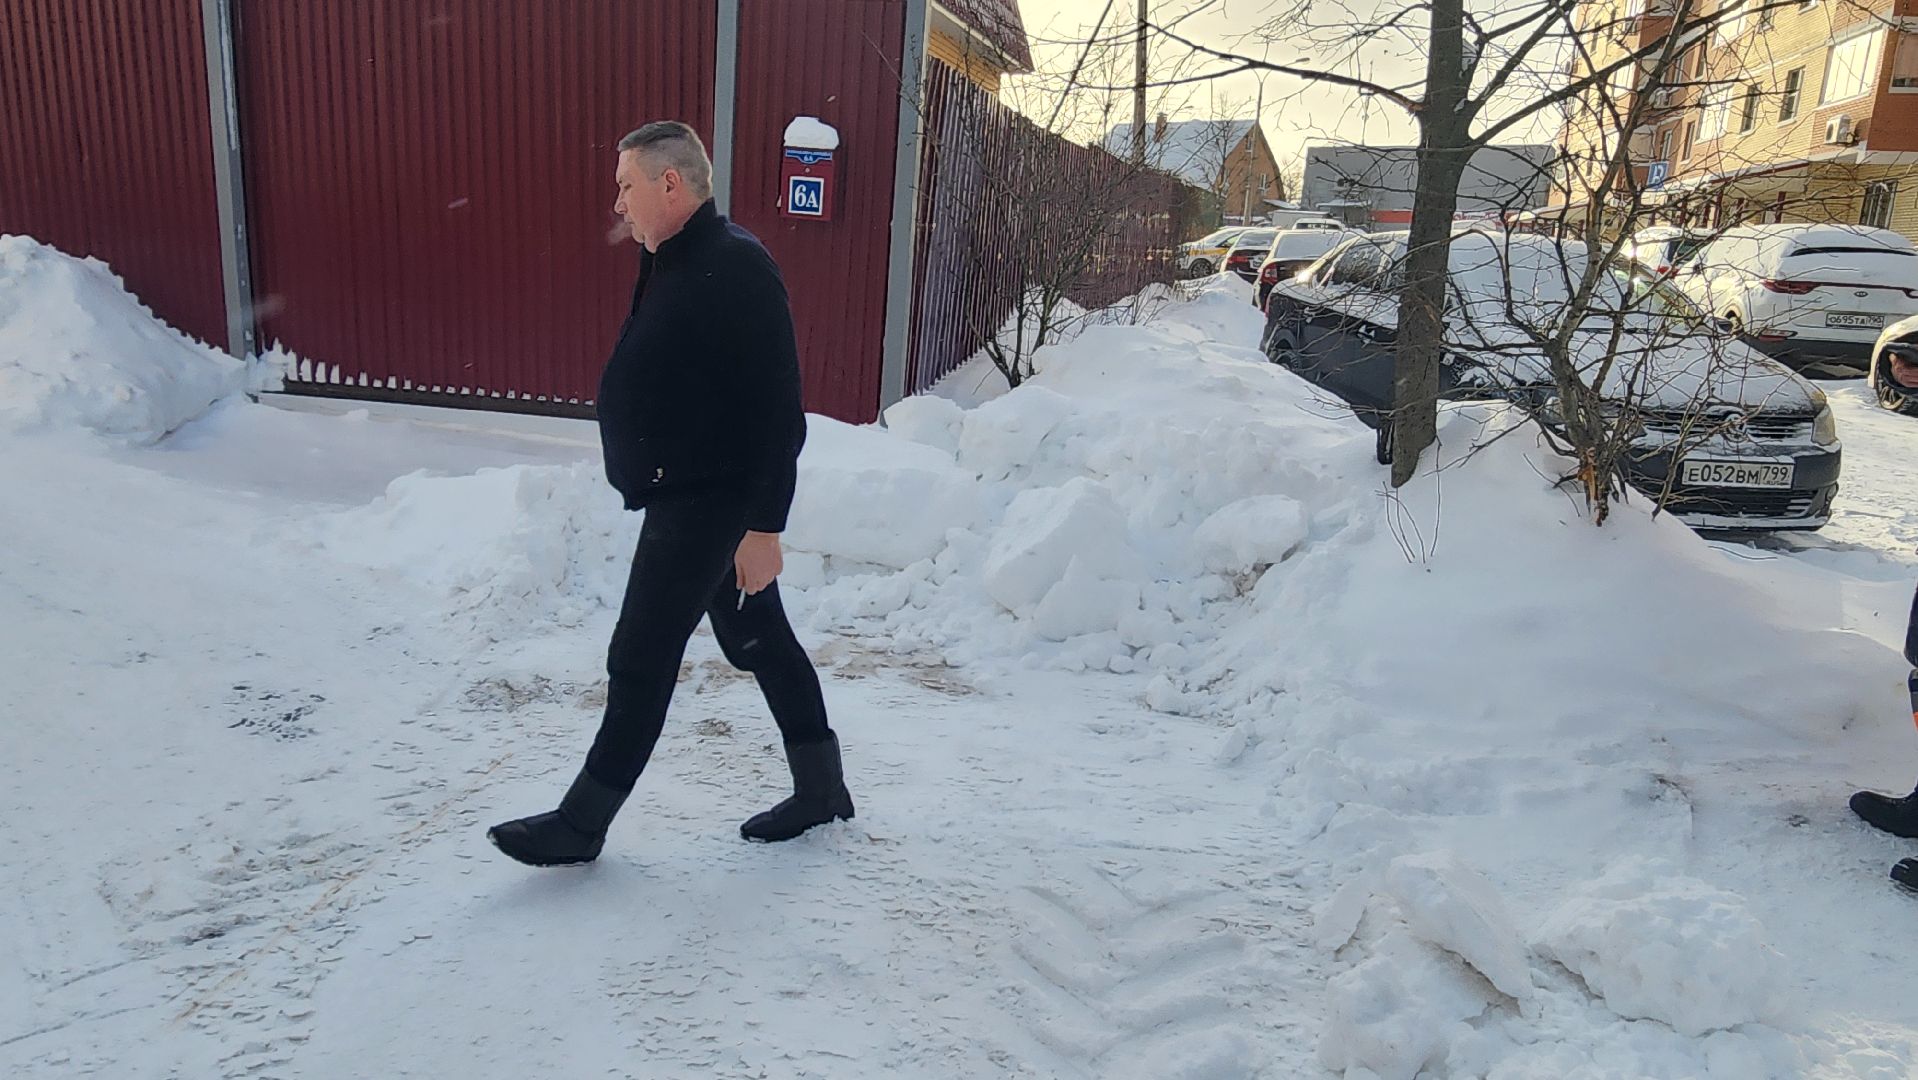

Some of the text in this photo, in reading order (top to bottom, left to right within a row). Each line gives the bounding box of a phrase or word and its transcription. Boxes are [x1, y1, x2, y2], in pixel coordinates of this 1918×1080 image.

[794, 184, 818, 208] 6А
[1689, 464, 1788, 485] Е052ВМ 799
